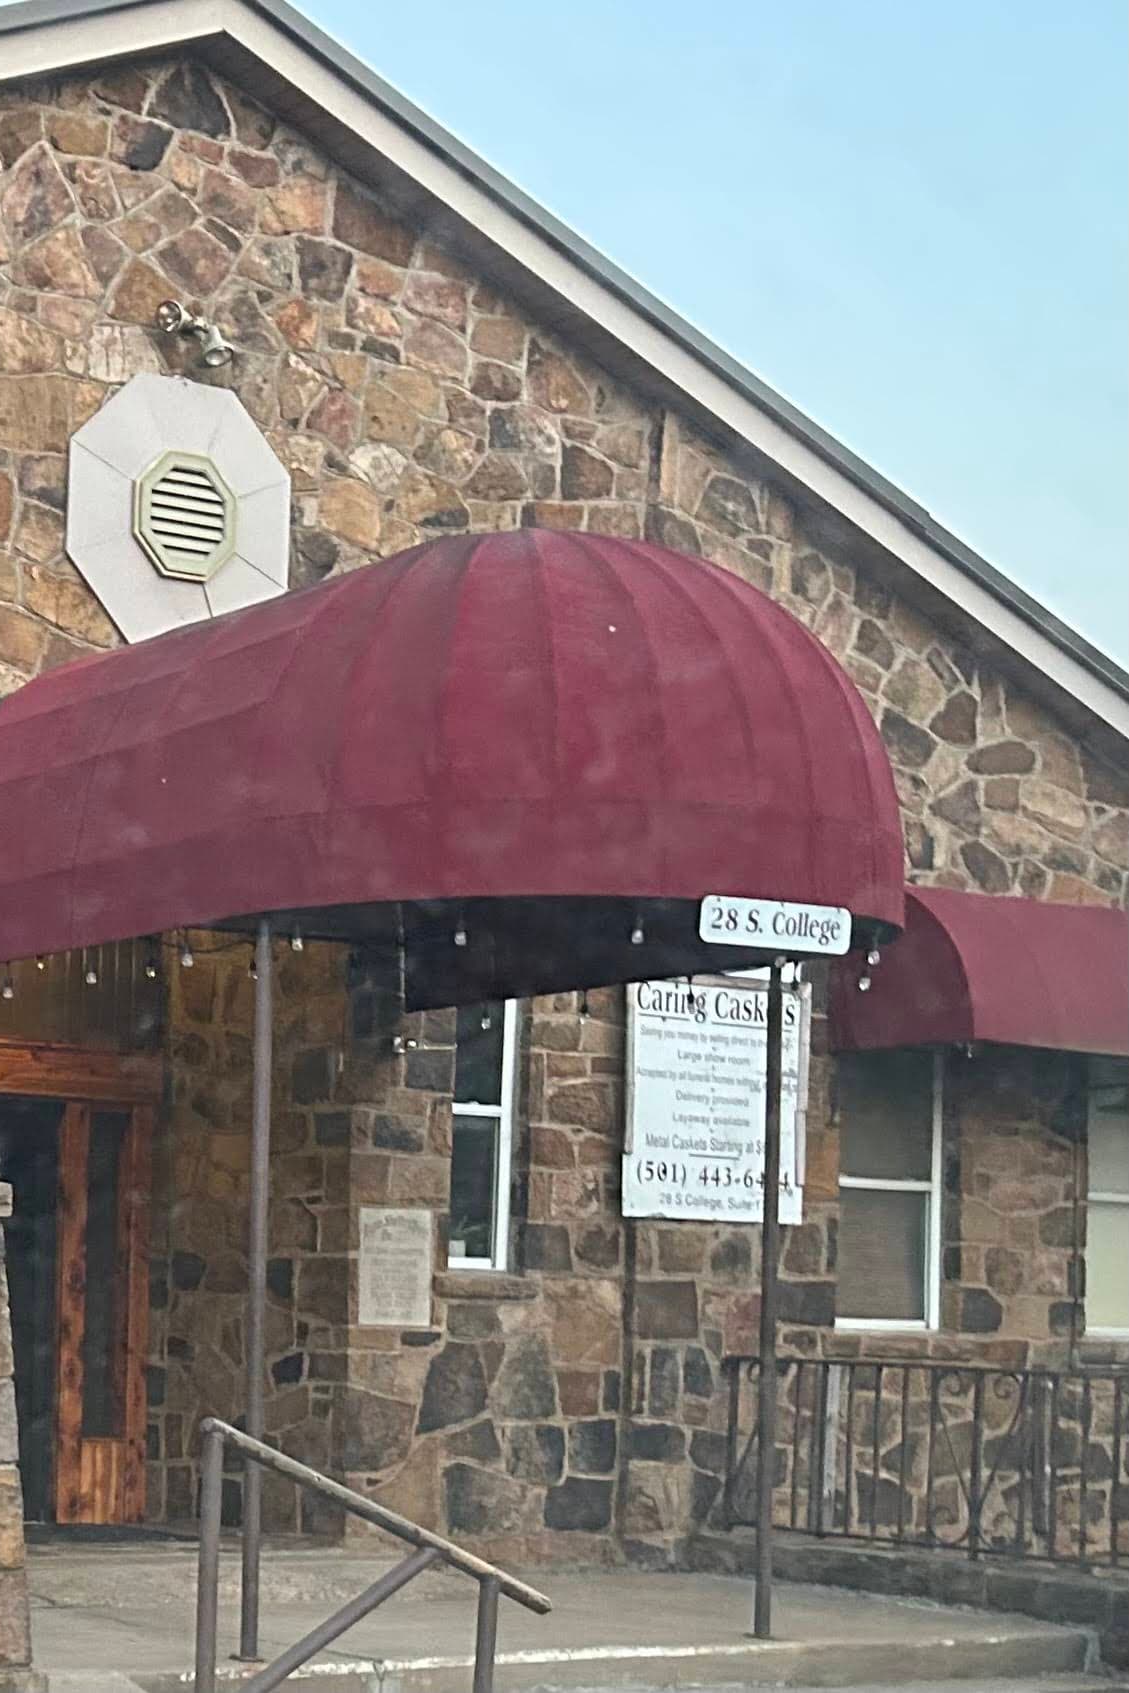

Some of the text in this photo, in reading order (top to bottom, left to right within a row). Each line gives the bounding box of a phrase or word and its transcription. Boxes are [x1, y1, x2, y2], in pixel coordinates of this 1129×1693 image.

[711, 906, 841, 946] 28 S. College
[715, 991, 795, 1026] Casks
[677, 1049, 750, 1066] Large show room
[646, 1133, 670, 1148] Metal
[672, 1134, 707, 1151] Caskets
[710, 1138, 743, 1156] Starting
[637, 1160, 789, 1191] (501) 443-644
